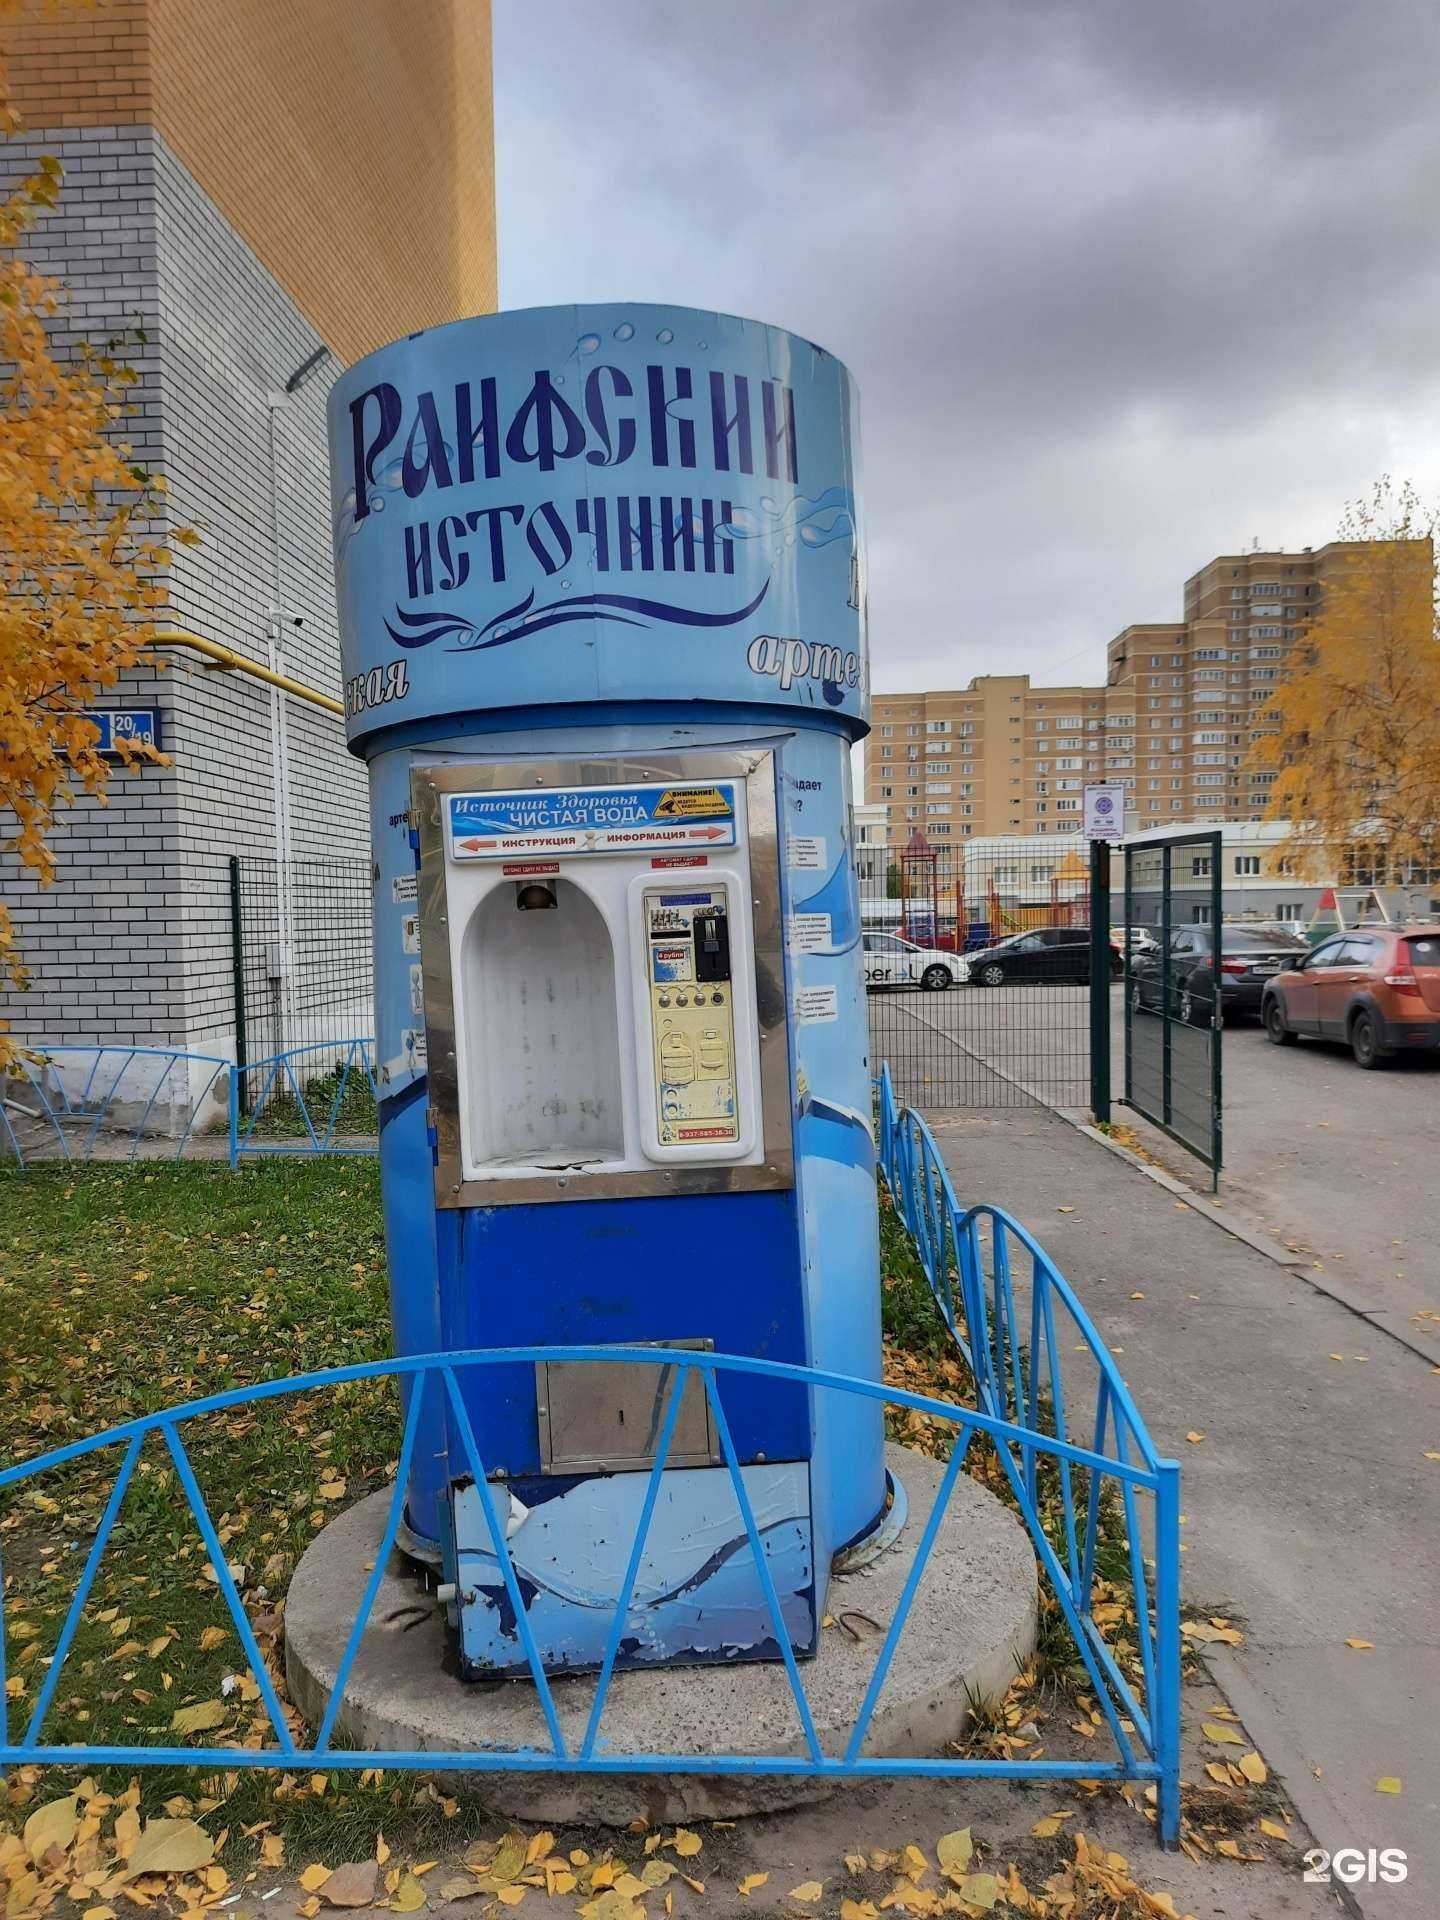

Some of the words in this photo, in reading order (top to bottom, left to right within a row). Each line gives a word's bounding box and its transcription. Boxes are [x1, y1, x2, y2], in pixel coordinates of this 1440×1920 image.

[404, 496, 735, 599] ИСТОЧНИК
[455, 799, 549, 813] Источник
[555, 792, 638, 811] Здоровья
[510, 809, 588, 826] ЧИСТАЯ
[594, 806, 649, 824] ВОДА
[502, 837, 576, 848] ИНСТРУКЦИЯ
[606, 831, 686, 843] ИНФОРМАЦИЯ
